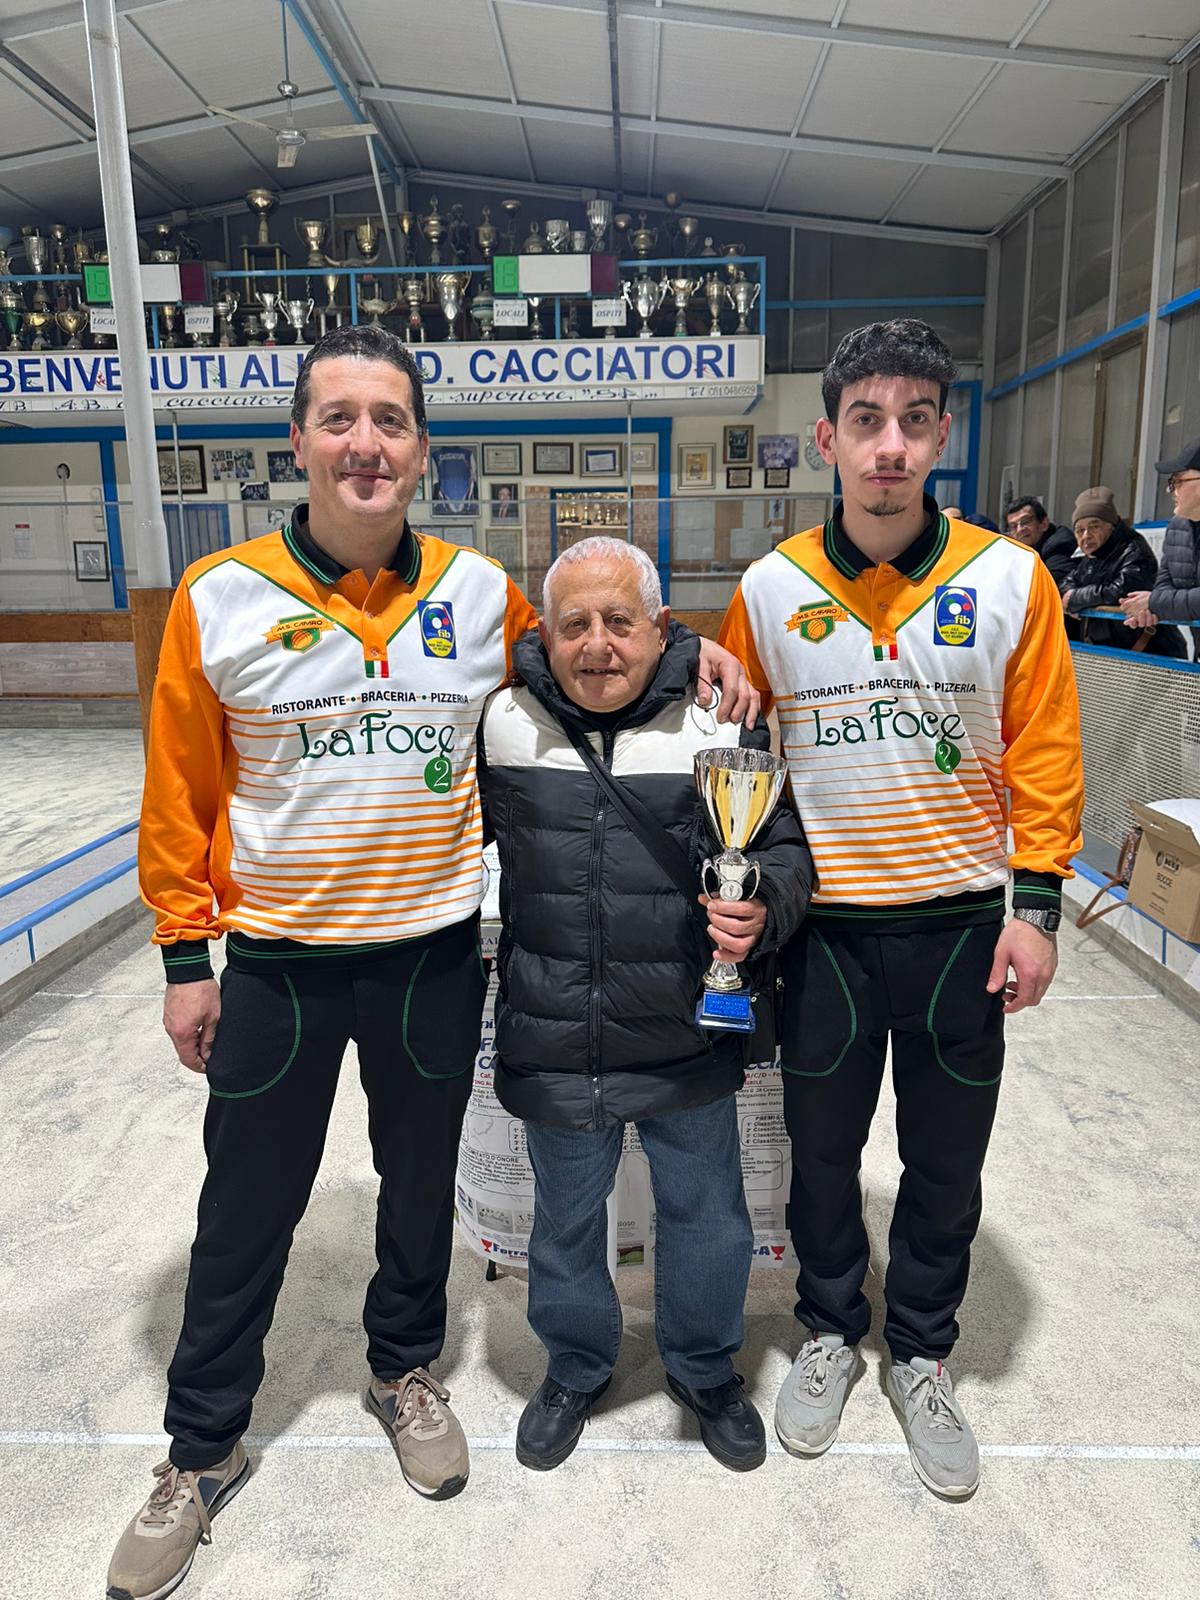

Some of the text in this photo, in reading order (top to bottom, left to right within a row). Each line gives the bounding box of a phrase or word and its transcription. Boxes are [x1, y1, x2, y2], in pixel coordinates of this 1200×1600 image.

[495, 309, 525, 318] LOCALI
[595, 309, 623, 318] OSPITI
[469, 343, 736, 385] CACCIATORI
[954, 614, 971, 625] fib
[437, 628, 451, 639] fib
[868, 678, 921, 691] BRACERIA
[934, 681, 977, 694] PIZZERIA
[271, 689, 470, 714] RISTORANTE BRACERIA PIZZERIA
[433, 760, 450, 788] 2
